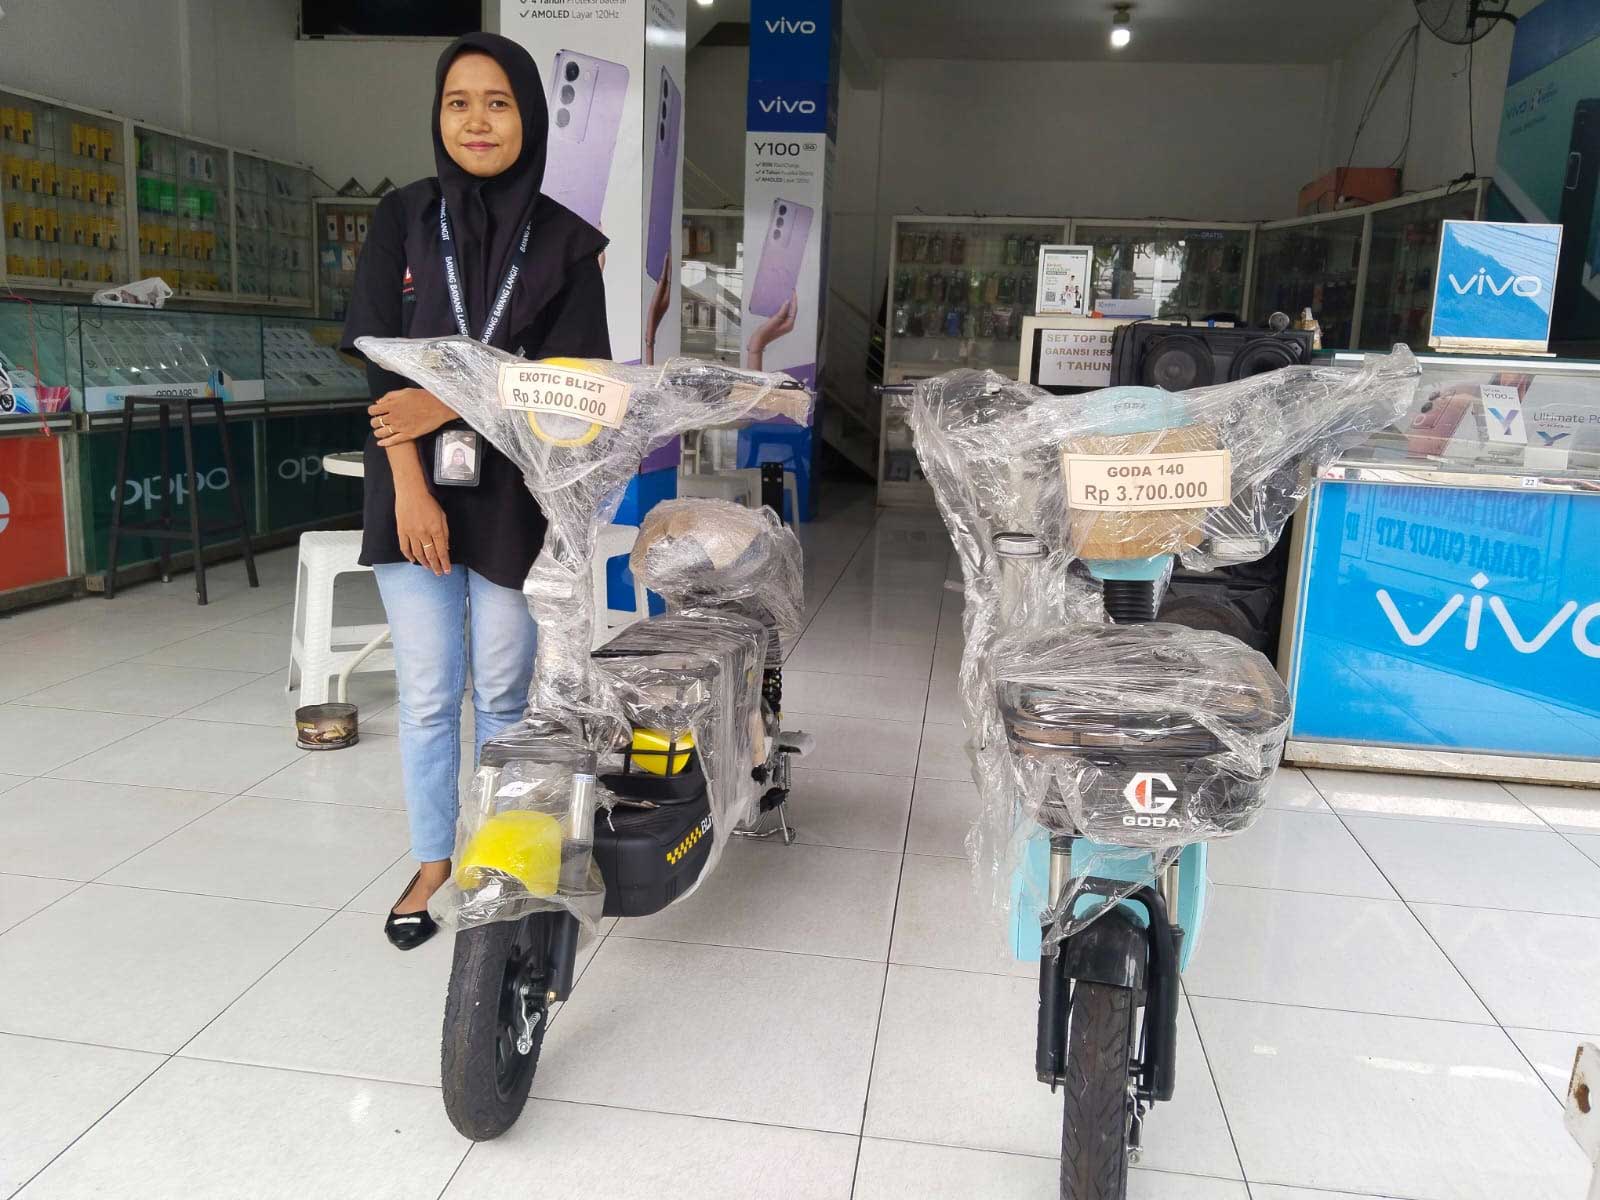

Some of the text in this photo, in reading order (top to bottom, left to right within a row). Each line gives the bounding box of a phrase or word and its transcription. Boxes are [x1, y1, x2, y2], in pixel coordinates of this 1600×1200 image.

[531, 10, 619, 20] AMOLED Layar 120Hz
[765, 17, 816, 34] vivo
[759, 96, 816, 114] vivo
[754, 142, 800, 156] Y100
[1449, 268, 1542, 297] vivo
[445, 256, 468, 337] BAYANG BAYANG LANGI
[481, 264, 519, 345] BAYANG BAYANG LANGIT
[1047, 334, 1068, 342] SET
[1073, 335, 1096, 343] TOP
[1045, 348, 1090, 356] GARANSI
[1057, 362, 1110, 370] 1 TAHUN
[519, 372, 605, 394] EXOTIC BLIZT
[512, 388, 606, 416] Rp 3.000.000
[1533, 411, 1585, 423] Ultimate
[1107, 464, 1184, 478] GODA 140
[111, 467, 230, 510] oppo
[1085, 482, 1208, 504] Rp 3.700.000
[1122, 816, 1181, 828] GODA
